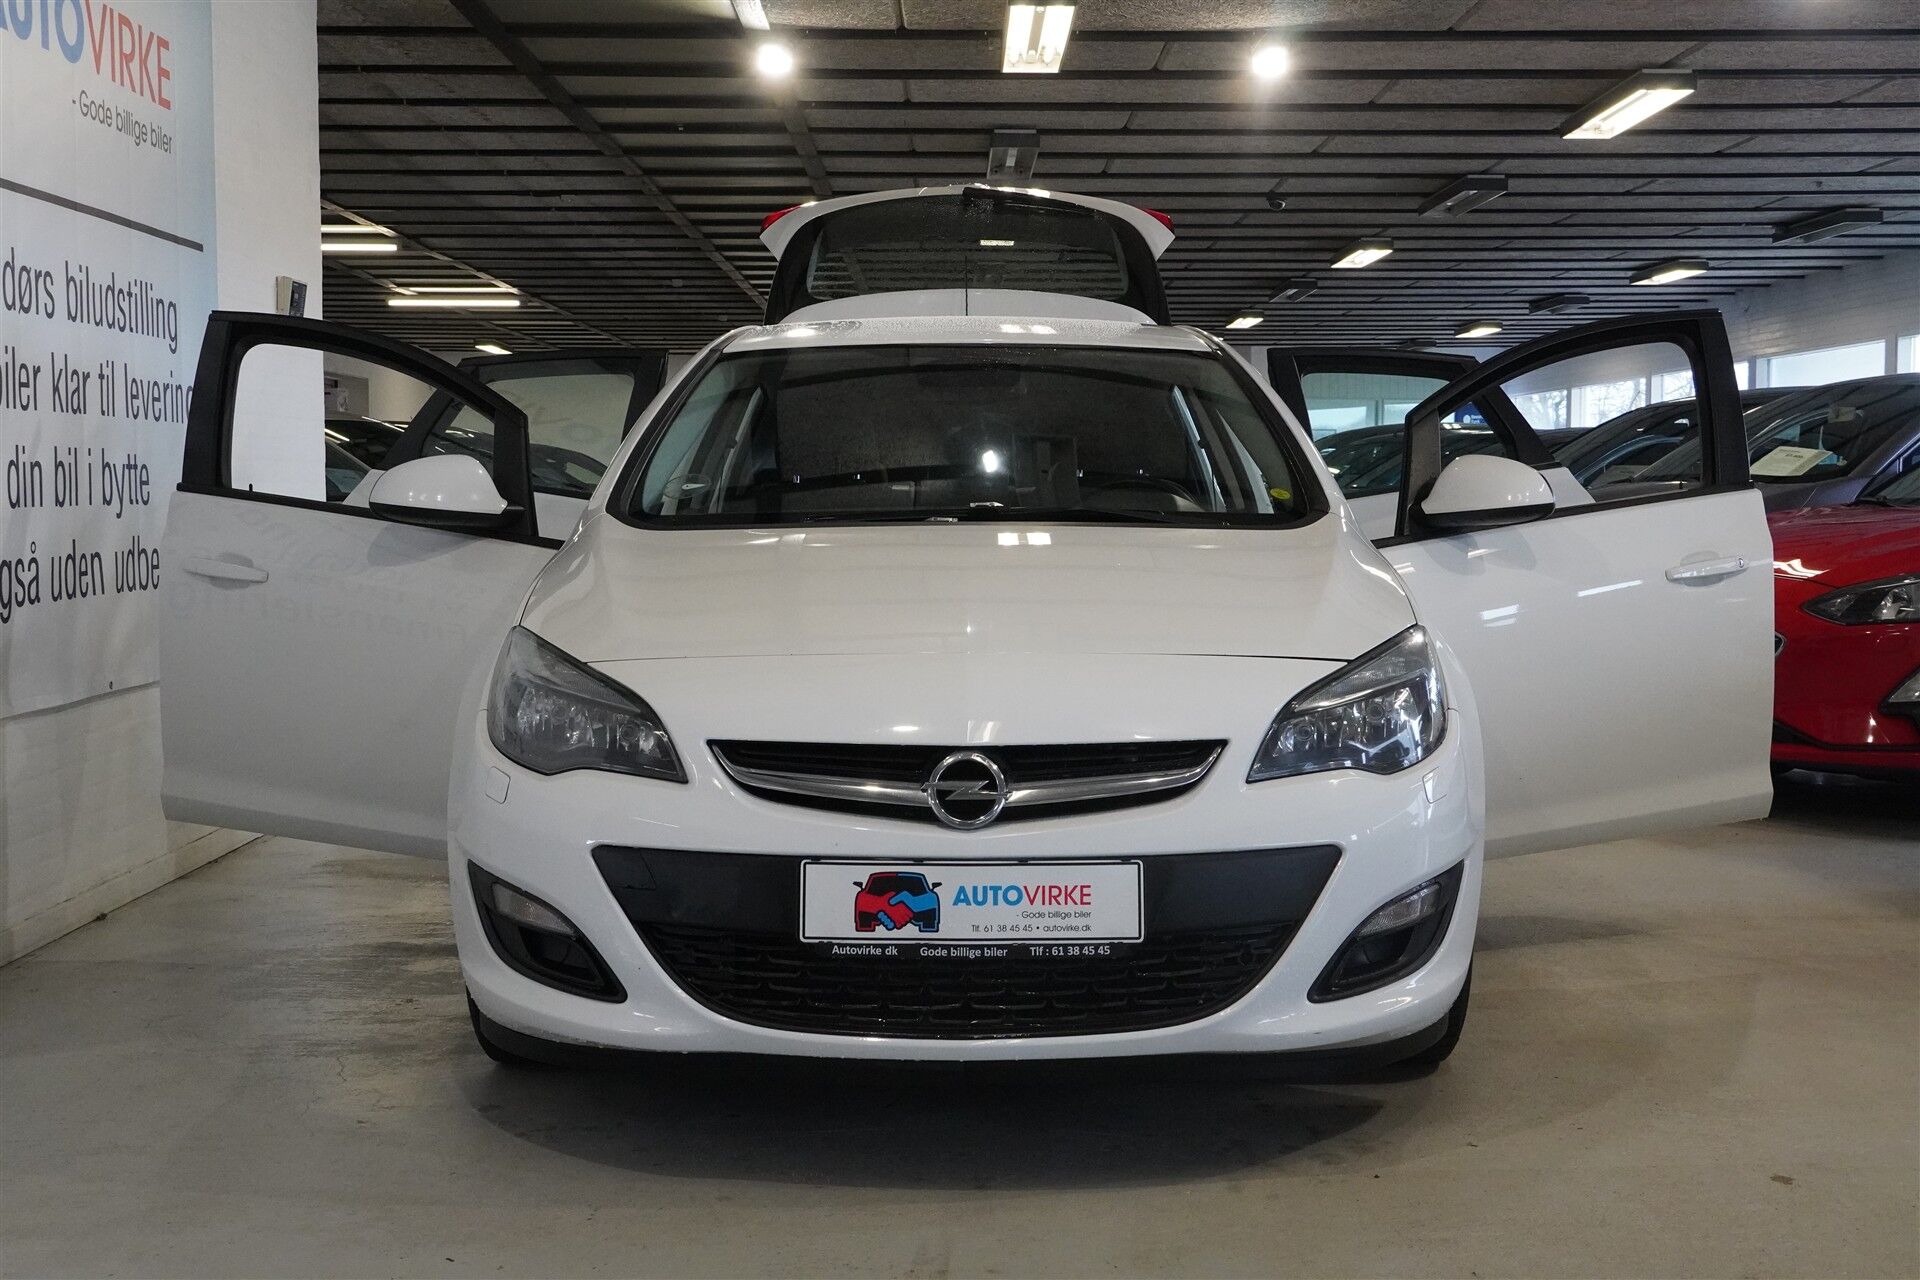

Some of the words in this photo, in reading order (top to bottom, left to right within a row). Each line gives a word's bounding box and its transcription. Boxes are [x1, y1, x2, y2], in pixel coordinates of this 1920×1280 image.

[0, 0, 171, 110] UTOVIRKE
[79, 89, 113, 128] Gode
[115, 105, 148, 147] billige
[150, 122, 172, 154] biler
[2, 247, 55, 319] dørs
[65, 260, 178, 354] biludstilling
[0, 345, 41, 412] iler
[51, 352, 91, 415] klar
[98, 360, 116, 417] til
[7, 444, 44, 509] din
[54, 446, 79, 508] bil
[88, 448, 93, 505] i
[101, 447, 150, 519] bytte
[0, 541, 41, 624] gså
[50, 539, 105, 602] uden
[114, 535, 160, 594] udbe
[952, 884, 1092, 906] AUTOVIRKE
[1021, 910, 1046, 919] Gode
[1048, 910, 1072, 920] billige
[1074, 910, 1092, 919] biler
[984, 924, 993, 933] 61
[997, 924, 1007, 933] 38
[1010, 924, 1020, 933] 45
[1022, 924, 1033, 933] 45
[1043, 924, 1092, 933] autovirke.dk
[832, 945, 882, 956] Autovirke
[885, 945, 898, 956] dk
[920, 946, 948, 957] Gode
[950, 947, 981, 959] billige
[984, 947, 1008, 957] biler
[1029, 946, 1044, 956] Tlf
[1051, 946, 1064, 956] 61
[1066, 946, 1080, 956] 38
[1082, 945, 1095, 956] 45
[1097, 945, 1111, 955] 45
